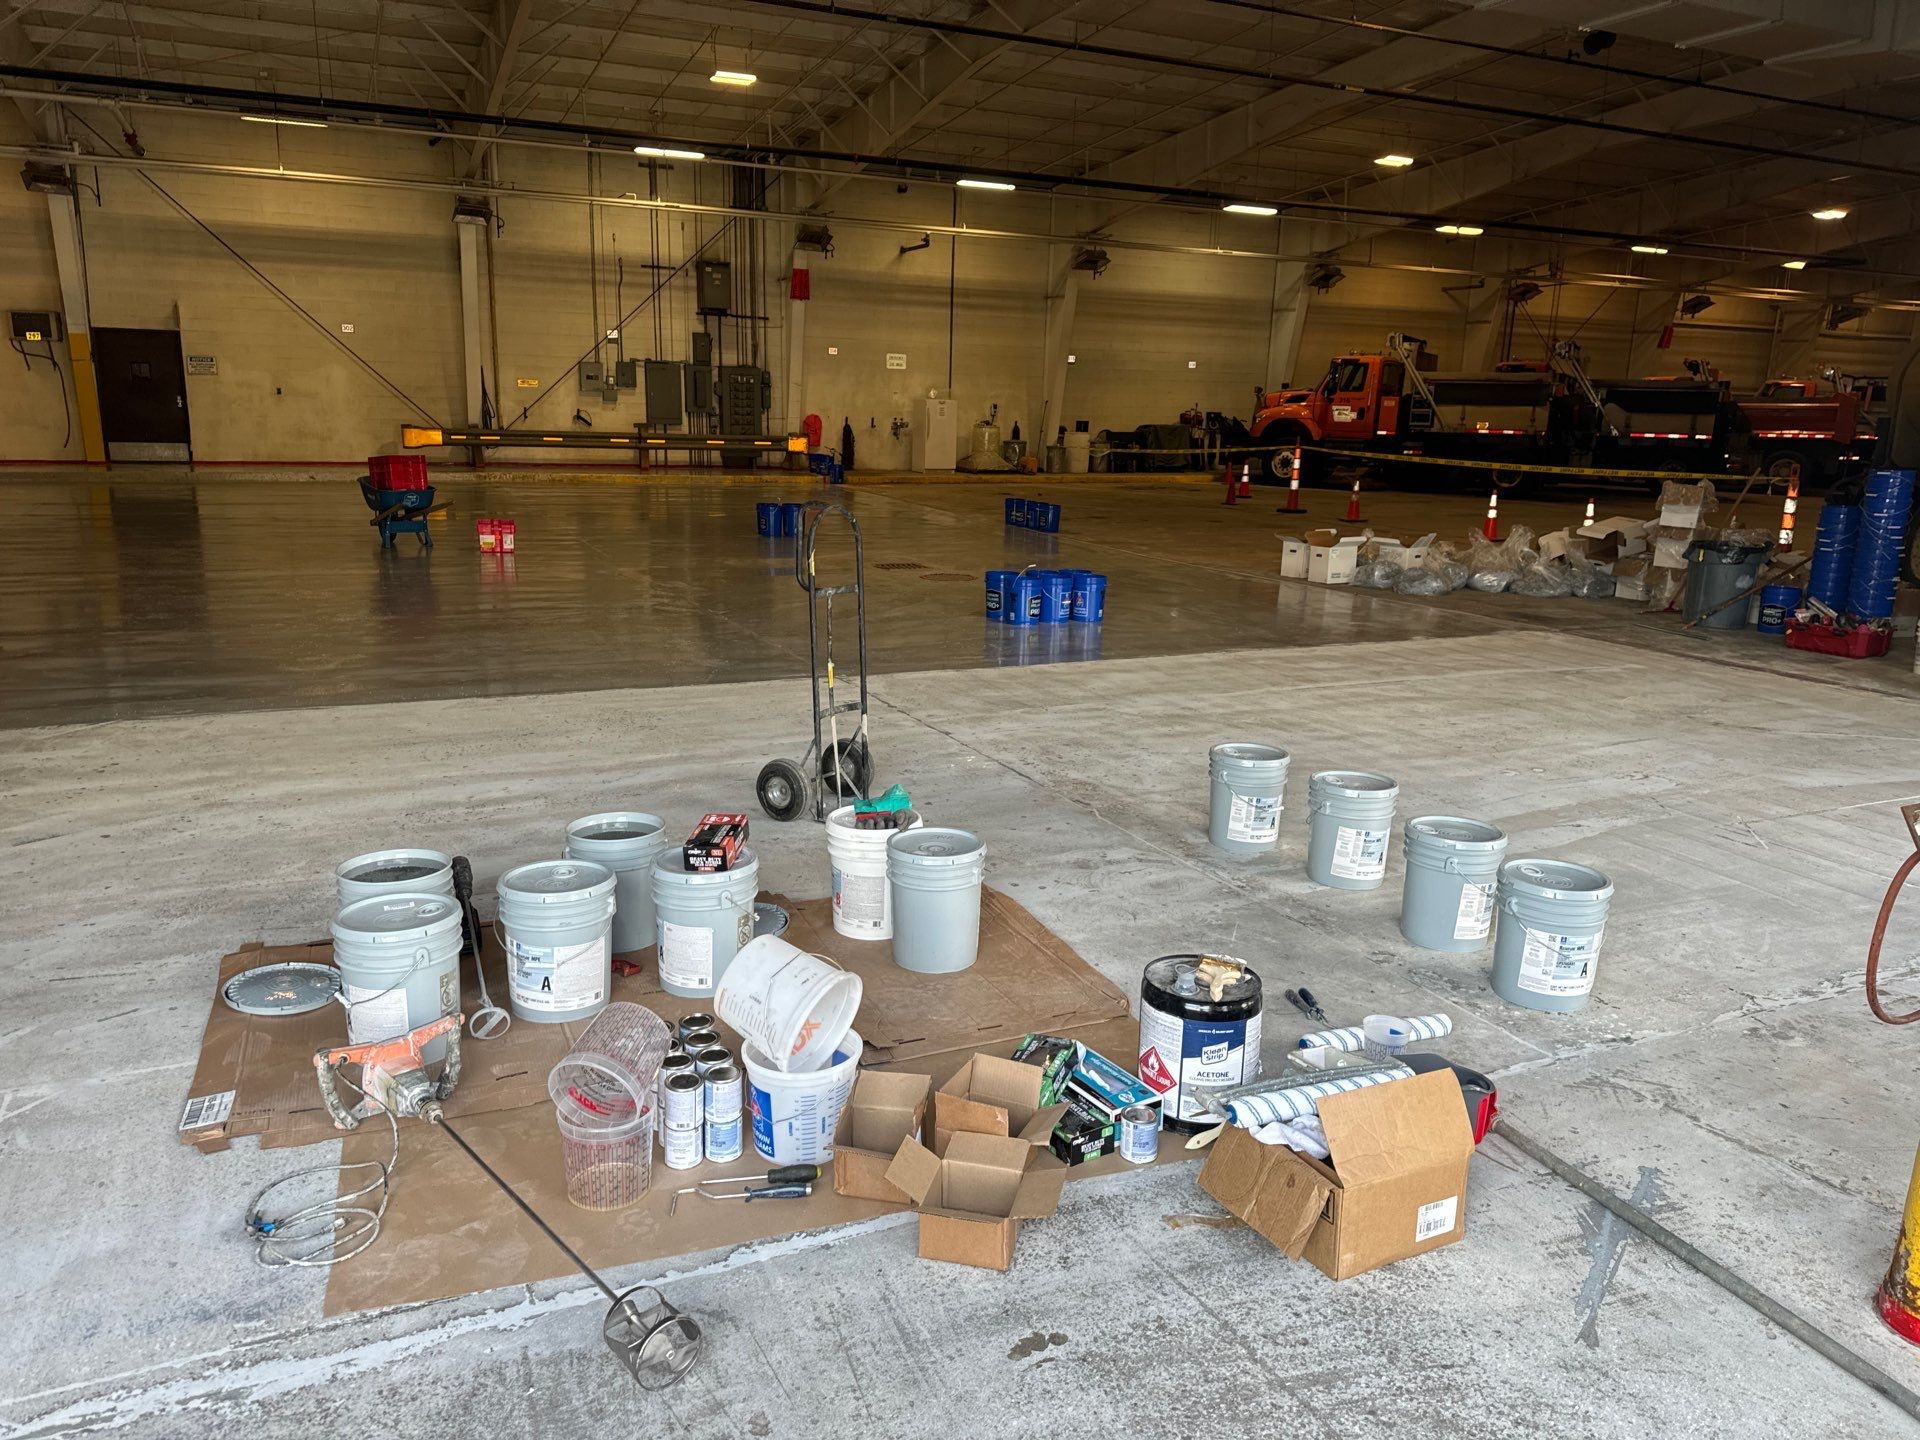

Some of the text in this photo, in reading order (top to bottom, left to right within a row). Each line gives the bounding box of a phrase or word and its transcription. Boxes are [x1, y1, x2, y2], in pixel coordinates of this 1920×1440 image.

[1580, 962, 1588, 977] A
[541, 976, 551, 991] A
[1203, 1046, 1227, 1056] Klean
[1205, 1053, 1224, 1061] Strip
